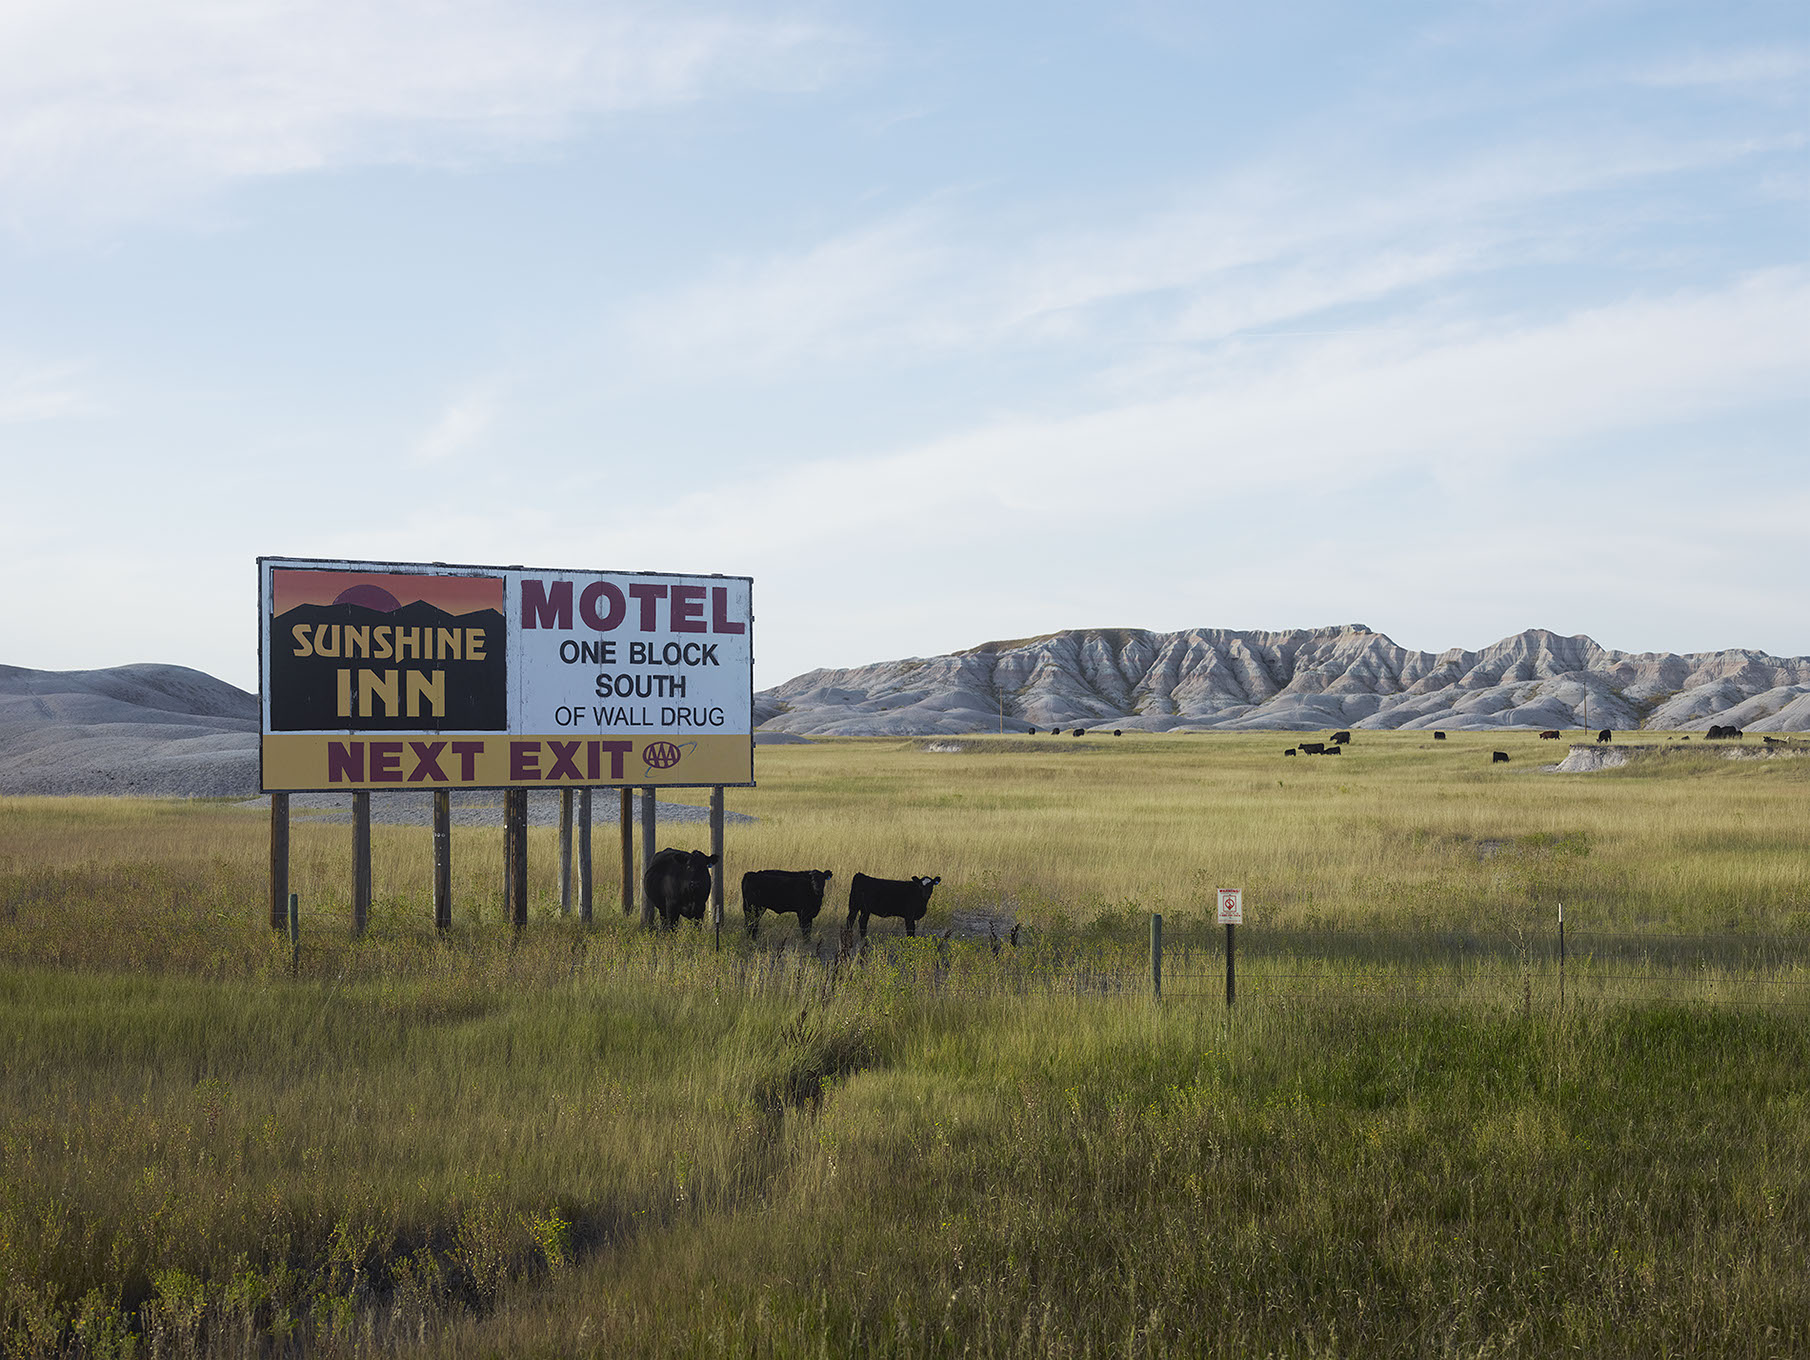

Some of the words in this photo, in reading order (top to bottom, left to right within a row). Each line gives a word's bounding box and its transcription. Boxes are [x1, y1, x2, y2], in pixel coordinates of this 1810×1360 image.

[521, 579, 745, 634] MOTEL
[291, 623, 487, 663] SUNSHINE
[559, 640, 616, 664] ONE
[629, 642, 719, 666] BLOCK
[337, 668, 445, 717] INN
[595, 673, 686, 698] SOUTH
[555, 706, 586, 726] OF
[593, 706, 654, 726] WALL
[661, 707, 724, 726] DRUG
[327, 741, 484, 782] NEXT
[509, 741, 632, 781] EXIT
[645, 742, 679, 768] AAA
